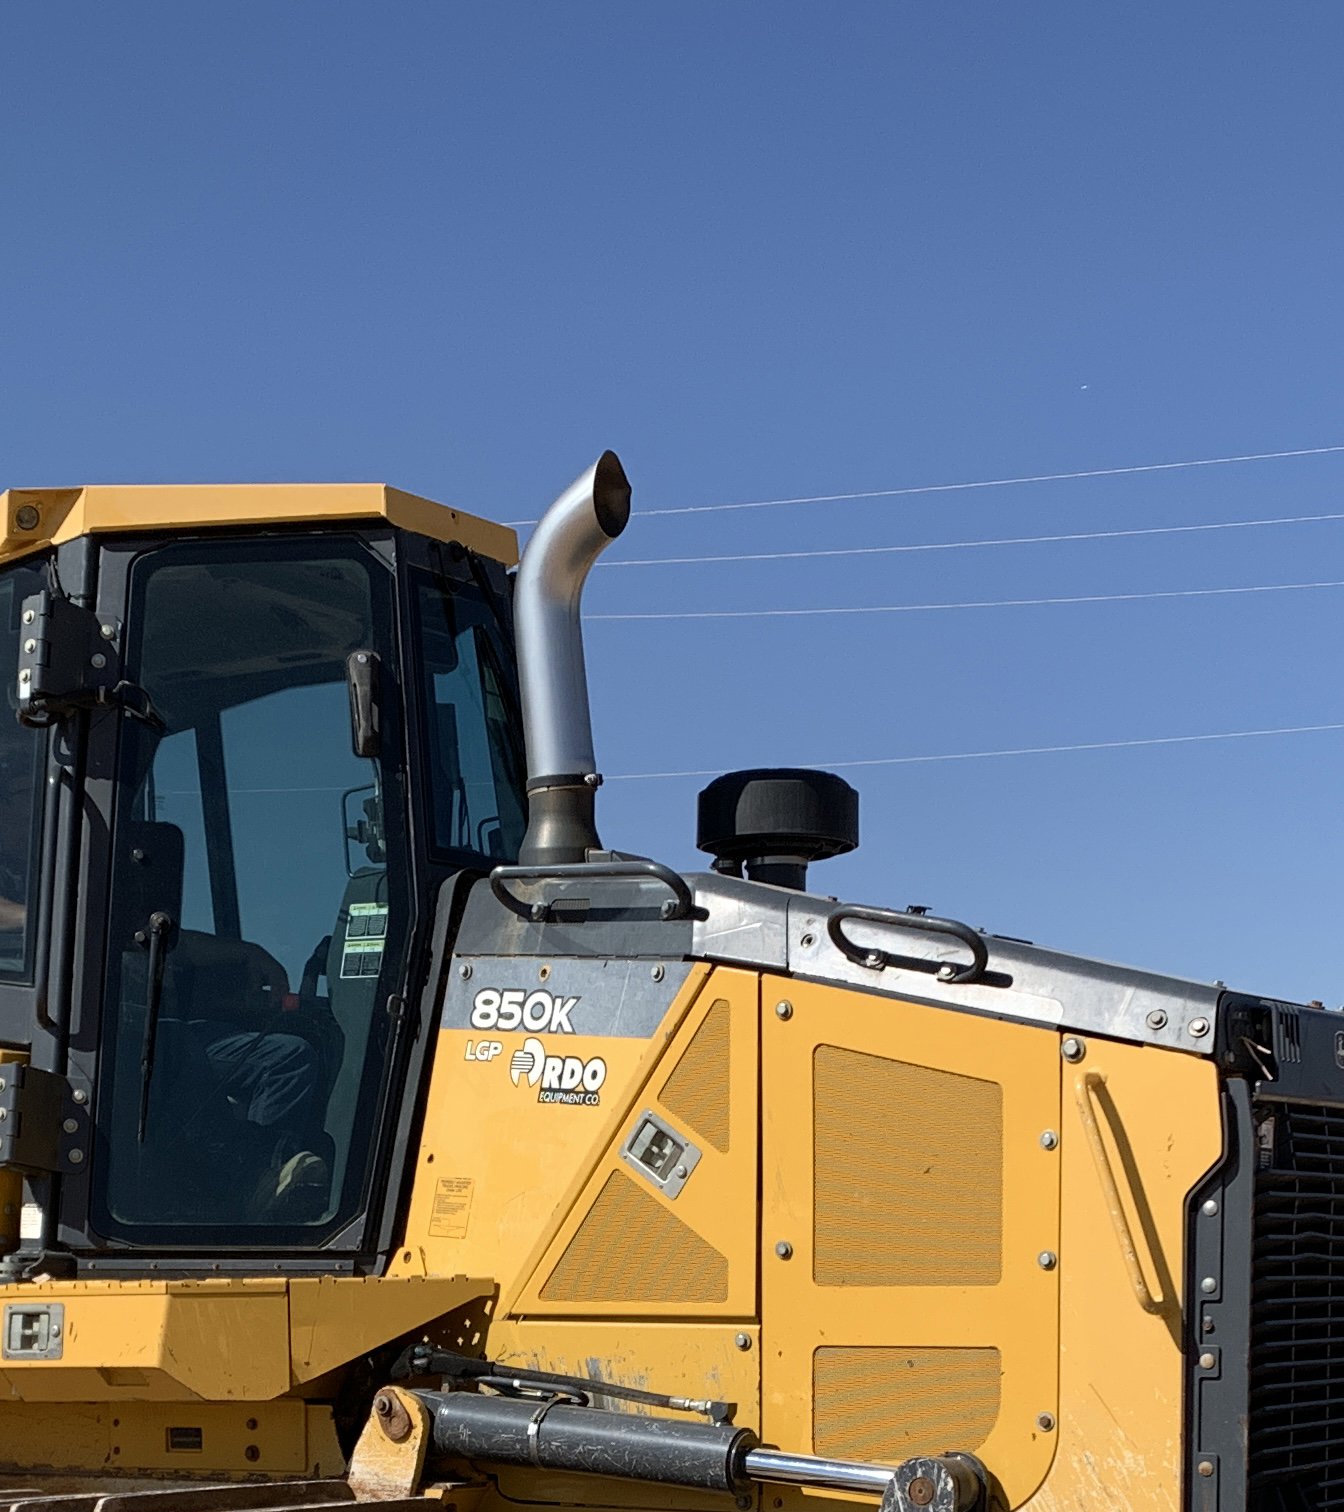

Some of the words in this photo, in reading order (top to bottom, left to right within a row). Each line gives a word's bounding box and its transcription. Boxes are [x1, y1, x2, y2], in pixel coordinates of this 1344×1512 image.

[470, 987, 581, 1034] 850K
[464, 1040, 503, 1062] LGP
[539, 1091, 584, 1104] EQUIPMENT
